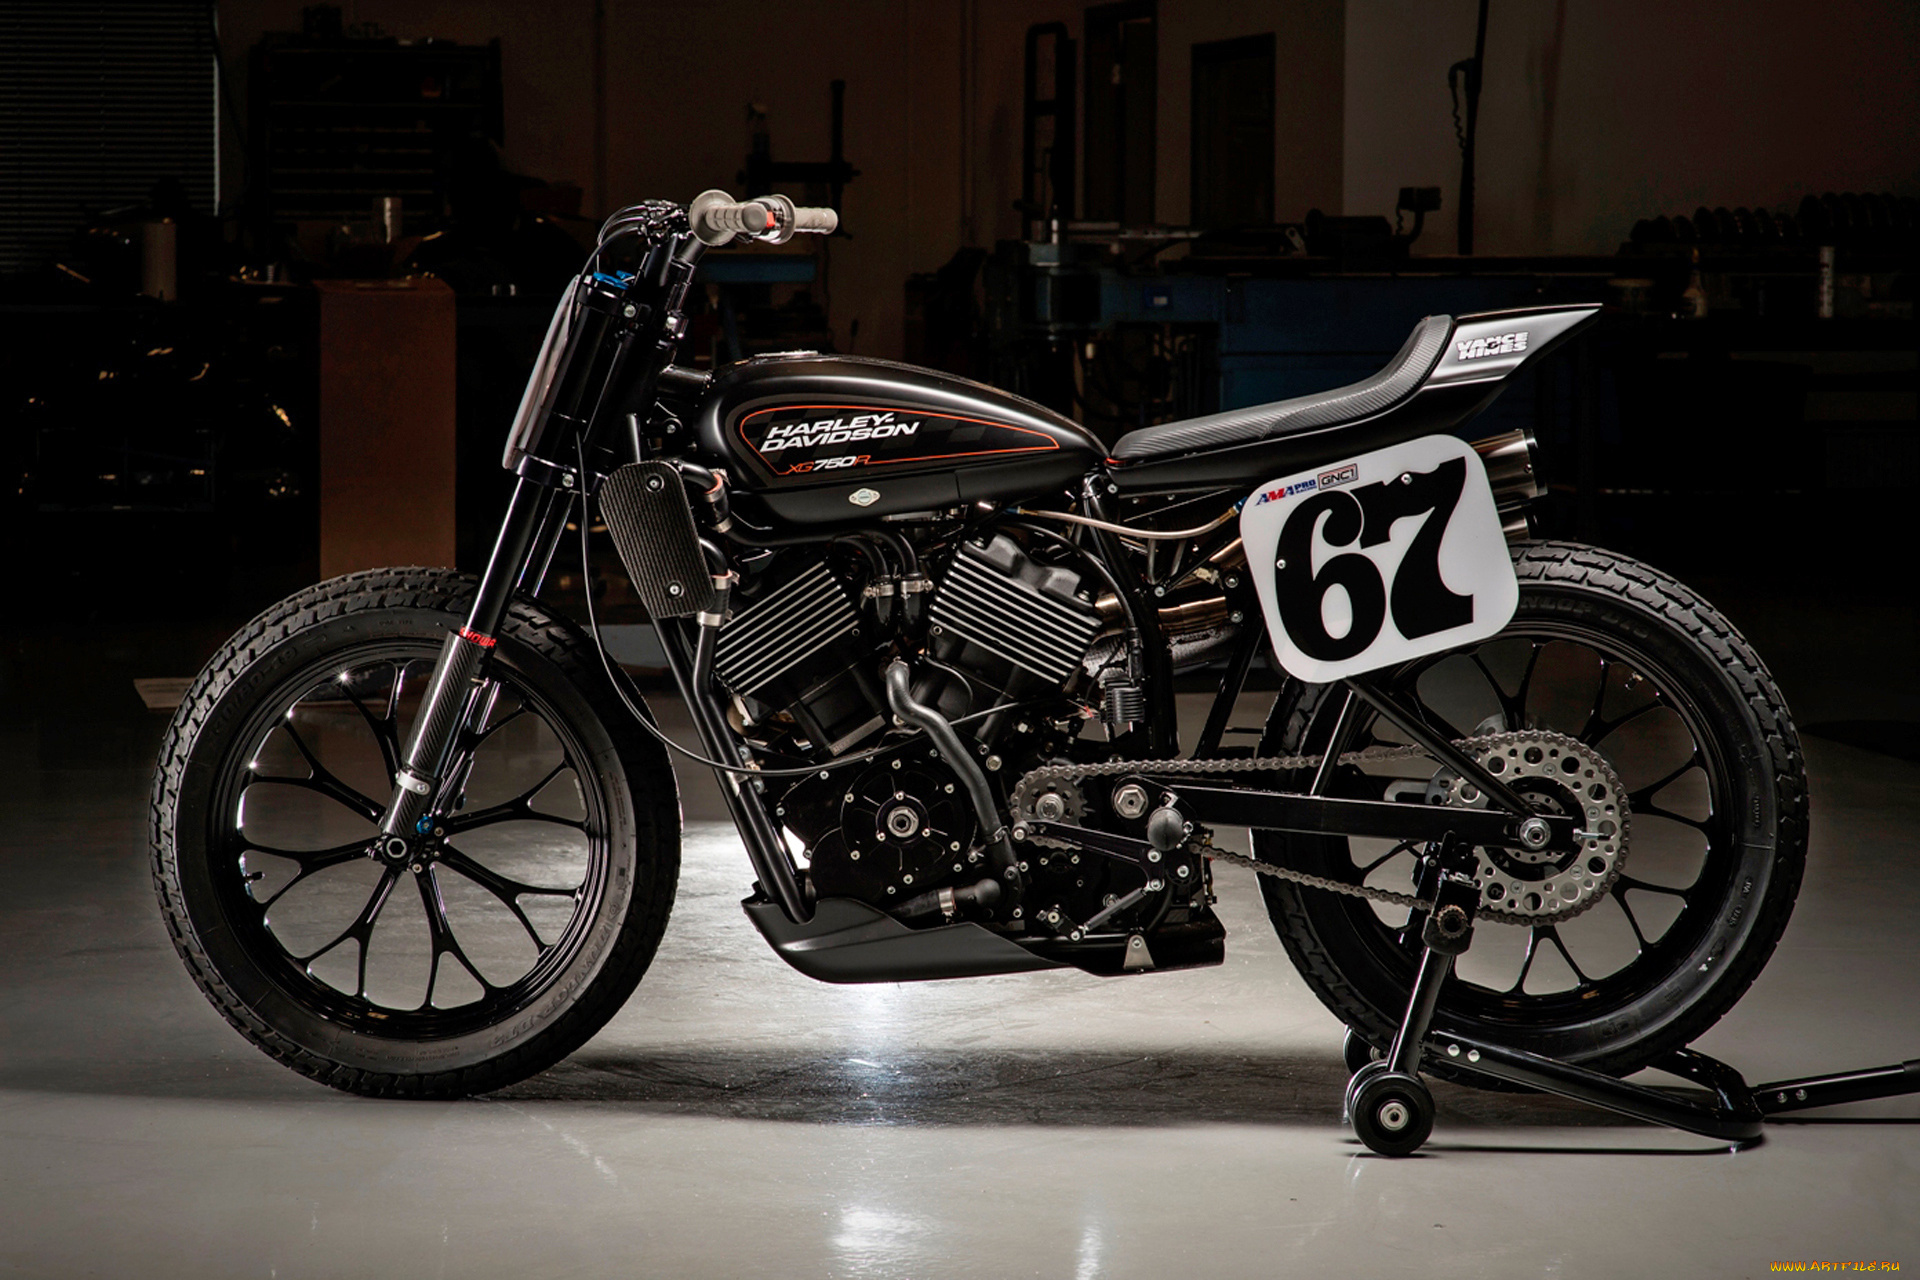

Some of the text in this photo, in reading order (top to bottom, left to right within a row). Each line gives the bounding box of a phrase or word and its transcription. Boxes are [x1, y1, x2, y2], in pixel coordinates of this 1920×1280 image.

[1456, 331, 1529, 352] VANCE
[1458, 341, 1528, 361] HINES
[760, 421, 919, 452] DAVIDSON
[767, 412, 895, 439] HARLEY-
[788, 454, 871, 474] XG750R
[1254, 467, 1356, 506] AMA PRO GNC1
[1274, 455, 1474, 662] 67
